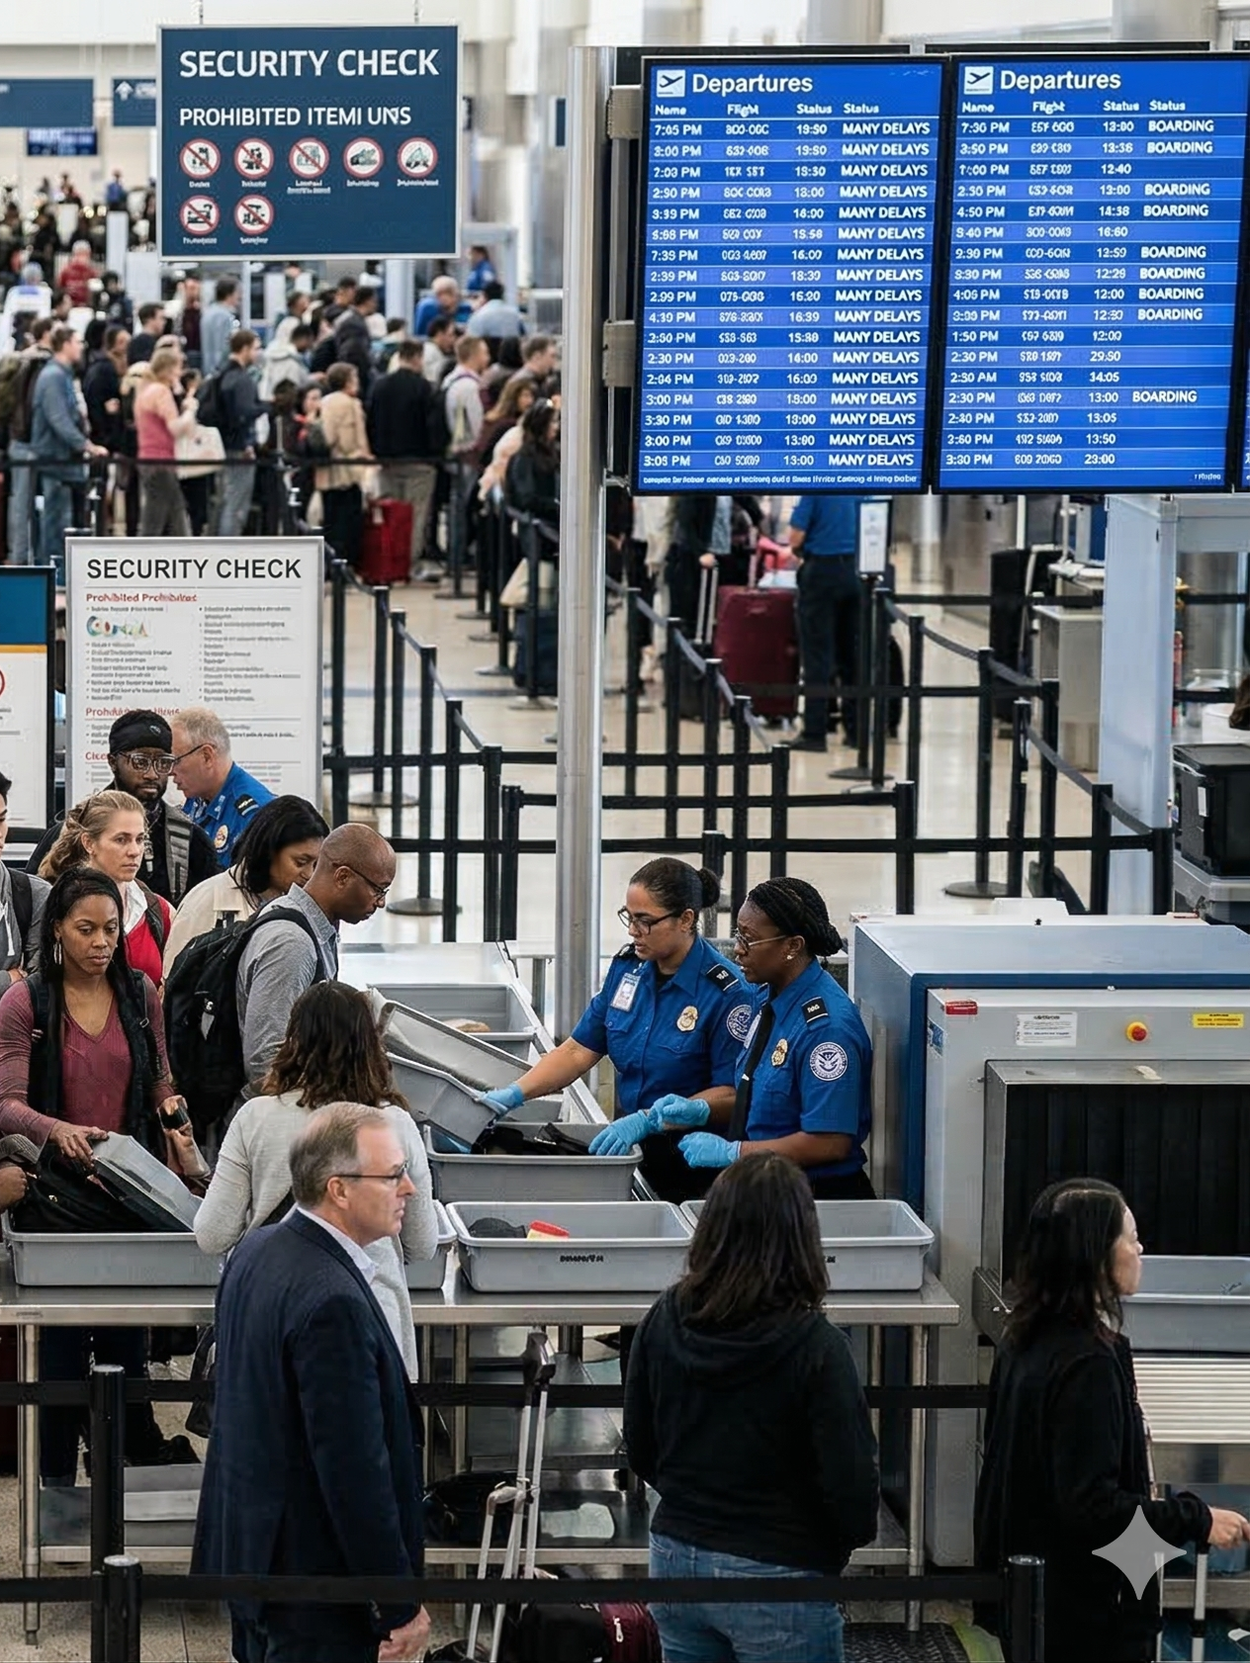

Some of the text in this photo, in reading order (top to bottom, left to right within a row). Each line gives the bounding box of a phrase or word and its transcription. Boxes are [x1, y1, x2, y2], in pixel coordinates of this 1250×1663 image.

[179, 49, 440, 77] SECURITY CHECK
[692, 74, 814, 97] Departures
[1000, 70, 1122, 94] Departures
[843, 103, 880, 114] Status
[1103, 100, 1140, 112] Status
[1149, 100, 1186, 112] Status
[179, 107, 301, 126] PROHIBITED
[307, 107, 362, 126] ITEMI
[683, 125, 701, 134] PM
[843, 123, 880, 134] MANY
[883, 123, 930, 134] DELAYS
[991, 122, 1009, 132] PM
[1149, 120, 1213, 132] BOARDING
[682, 146, 701, 156] PM
[842, 144, 879, 155] MANY
[882, 144, 929, 155] DELAYS
[989, 144, 1008, 153] PM
[1147, 141, 1212, 153] BOARDING
[682, 167, 700, 177] PM
[841, 165, 878, 176] MANY
[881, 165, 927, 176] DELAYS
[991, 165, 1009, 174] PM
[681, 188, 700, 198] PM
[840, 186, 877, 197] MANY
[880, 186, 927, 197] DELAYS
[987, 186, 1005, 196] PM
[1145, 184, 1210, 195] BOARDING
[680, 209, 699, 219] PM
[839, 207, 876, 218] MANY
[879, 207, 926, 218] DELAYS
[957, 207, 983, 217] 4:50
[986, 207, 1004, 216] PM
[1144, 205, 1208, 216] BOARDING
[680, 229, 698, 239] PM
[839, 228, 875, 239] MANY
[878, 228, 925, 239] DELAYS
[984, 227, 1003, 237] PM
[679, 250, 697, 260] PM
[838, 249, 874, 259] MANY
[877, 249, 924, 260] DELAYS
[984, 248, 1002, 258] PM
[1141, 246, 1206, 258] BOARDING
[678, 271, 697, 281] PM
[837, 270, 874, 280] MANY
[876, 269, 923, 280] DELAYS
[983, 269, 1001, 279] PM
[1140, 268, 1205, 279] BOARDING
[677, 290, 922, 301] PM MANY DELAYS
[981, 289, 1000, 299] PM
[1094, 289, 1124, 299] 12:00
[1139, 288, 1203, 299] BOARDING
[677, 312, 695, 322] PM
[835, 311, 871, 322] MANY
[874, 311, 921, 322] DELAYS
[981, 310, 1000, 320] PM
[1138, 308, 1202, 320] BOARDING
[676, 333, 695, 342] PM
[834, 332, 870, 342] MANY
[874, 331, 920, 342] DELAYS
[980, 331, 998, 341] PM
[675, 353, 693, 363] PM
[833, 352, 870, 363] MANY
[873, 352, 919, 363] DELAYS
[951, 352, 976, 362] 2:30
[979, 352, 997, 361] PM
[675, 374, 693, 384] PM
[833, 373, 869, 383] MANY
[872, 372, 918, 384] DELAYS
[977, 372, 996, 382] AM
[675, 394, 693, 404] PM
[831, 393, 868, 404] MANY
[871, 393, 916, 404] DELAYS
[949, 391, 1197, 403] 2:30 PM 13:00 BOARDING
[674, 415, 691, 424] PM
[831, 414, 867, 424] MANY
[870, 413, 915, 424] DELAYS
[976, 413, 994, 423] PM
[673, 436, 691, 445] PM
[830, 434, 866, 445] MANY
[869, 434, 914, 445] DELAYS
[975, 434, 1116, 444] PM 13:50
[672, 456, 690, 465] PM
[784, 455, 814, 465] 13:00
[829, 454, 865, 465] MANY
[868, 454, 913, 465] DELAYS
[974, 454, 992, 464] PM
[87, 558, 302, 580] SECURITY CHECK
